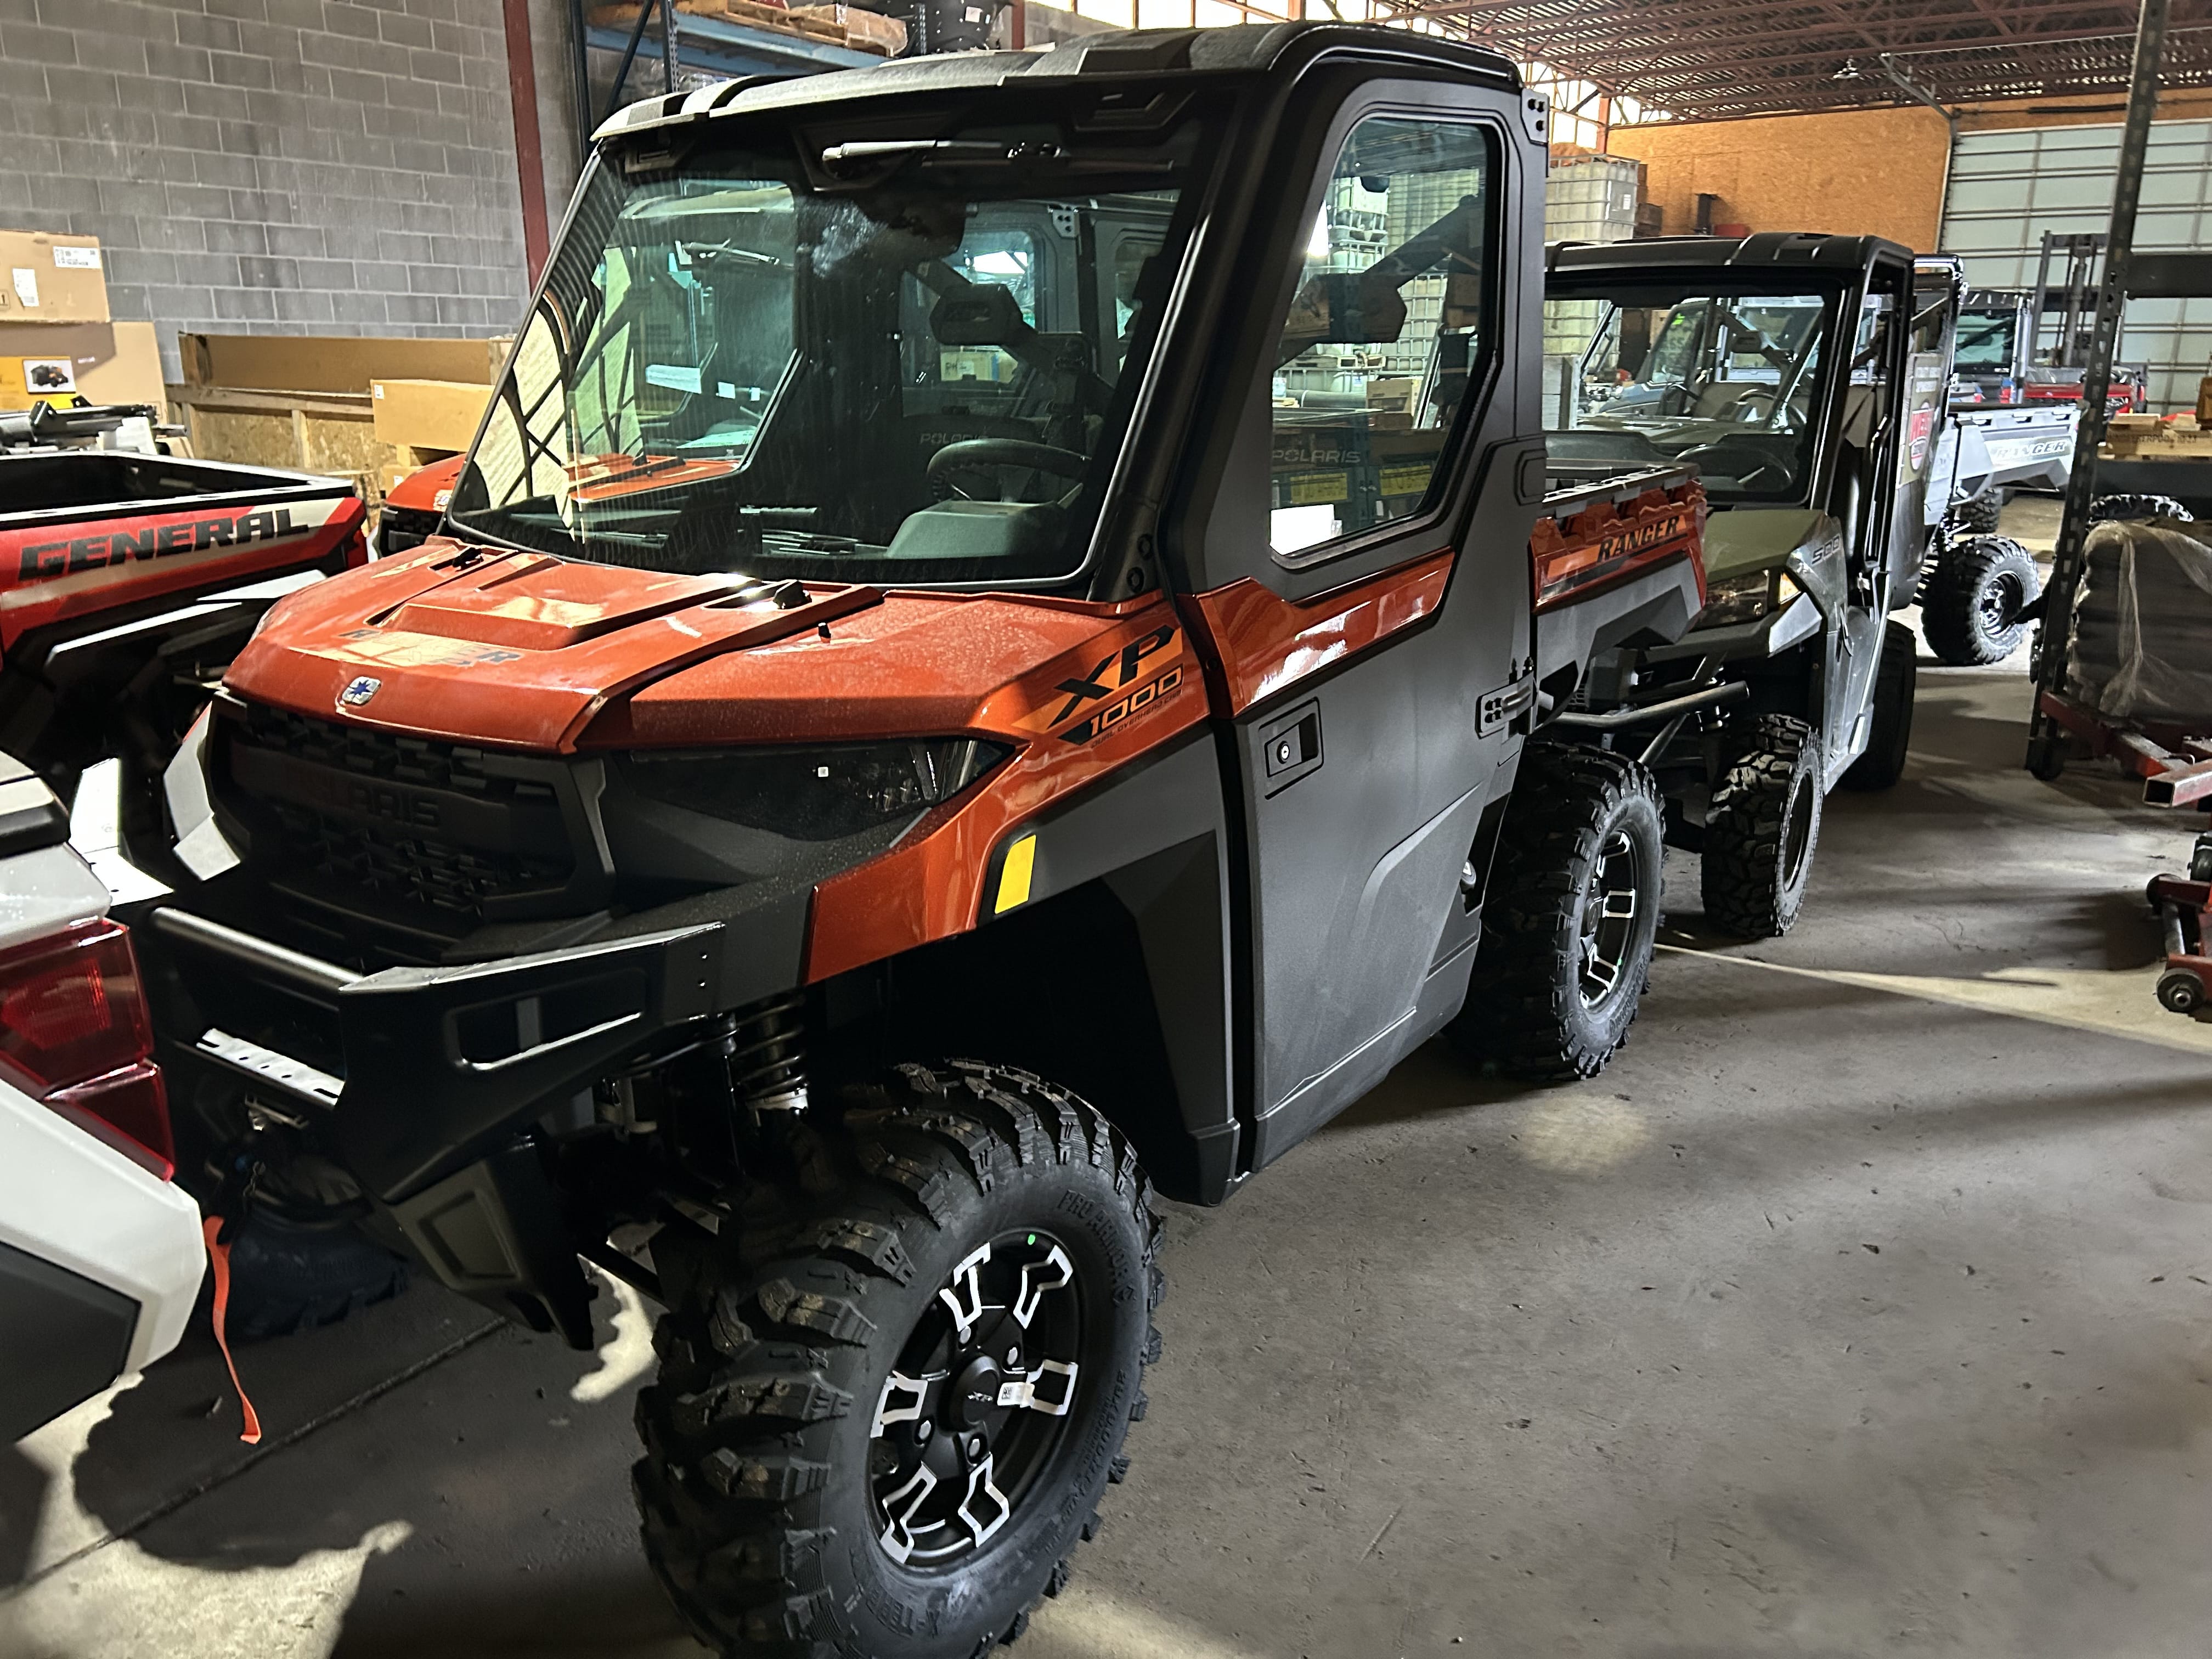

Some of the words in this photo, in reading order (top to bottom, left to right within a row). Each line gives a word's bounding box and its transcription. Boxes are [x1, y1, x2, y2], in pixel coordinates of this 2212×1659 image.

[920, 432, 985, 445] POLAR
[1273, 448, 1361, 463] POLARIS
[18, 508, 309, 581] GENERAL
[1597, 515, 1680, 563] RANGER
[1812, 535, 1840, 565] 500
[1046, 624, 1176, 730] XP
[1091, 667, 1182, 736] 1000
[1091, 730, 1115, 749] DUAL
[1117, 700, 1163, 732] OVERHEAD
[1164, 689, 1182, 704] CAM
